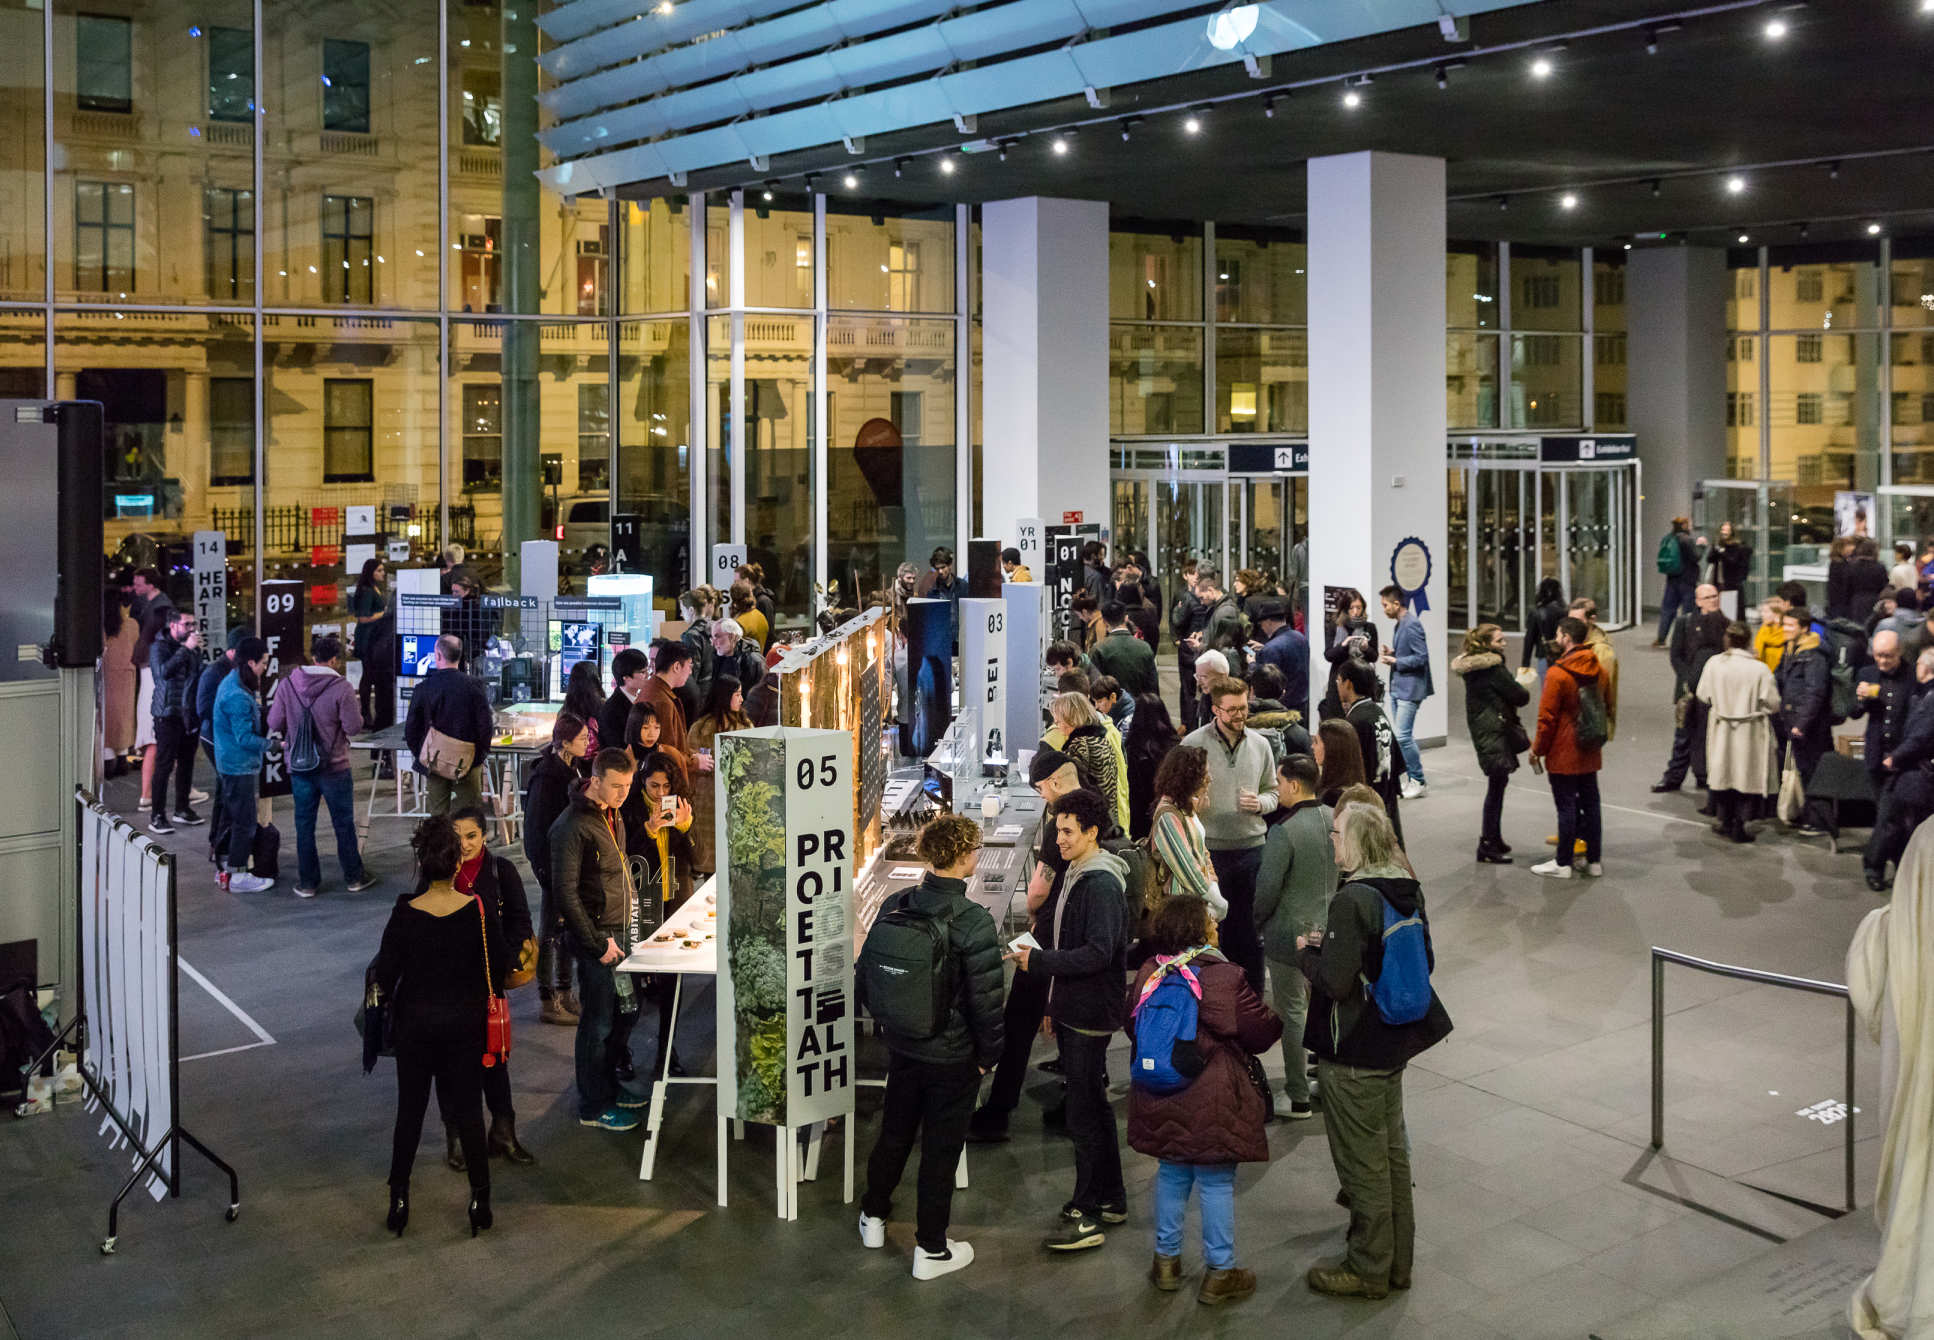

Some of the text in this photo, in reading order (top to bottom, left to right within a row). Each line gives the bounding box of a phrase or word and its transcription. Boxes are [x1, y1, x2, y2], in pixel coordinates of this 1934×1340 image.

[615, 522, 633, 535] 11
[1019, 526, 1035, 537] YR
[199, 541, 218, 555] 14
[1019, 538, 1037, 551] 01
[1060, 545, 1077, 560] 01
[718, 554, 739, 569] 08
[266, 593, 295, 613] 09
[484, 596, 537, 609] fallback
[988, 612, 1003, 634] 03
[796, 754, 837, 790] 05
